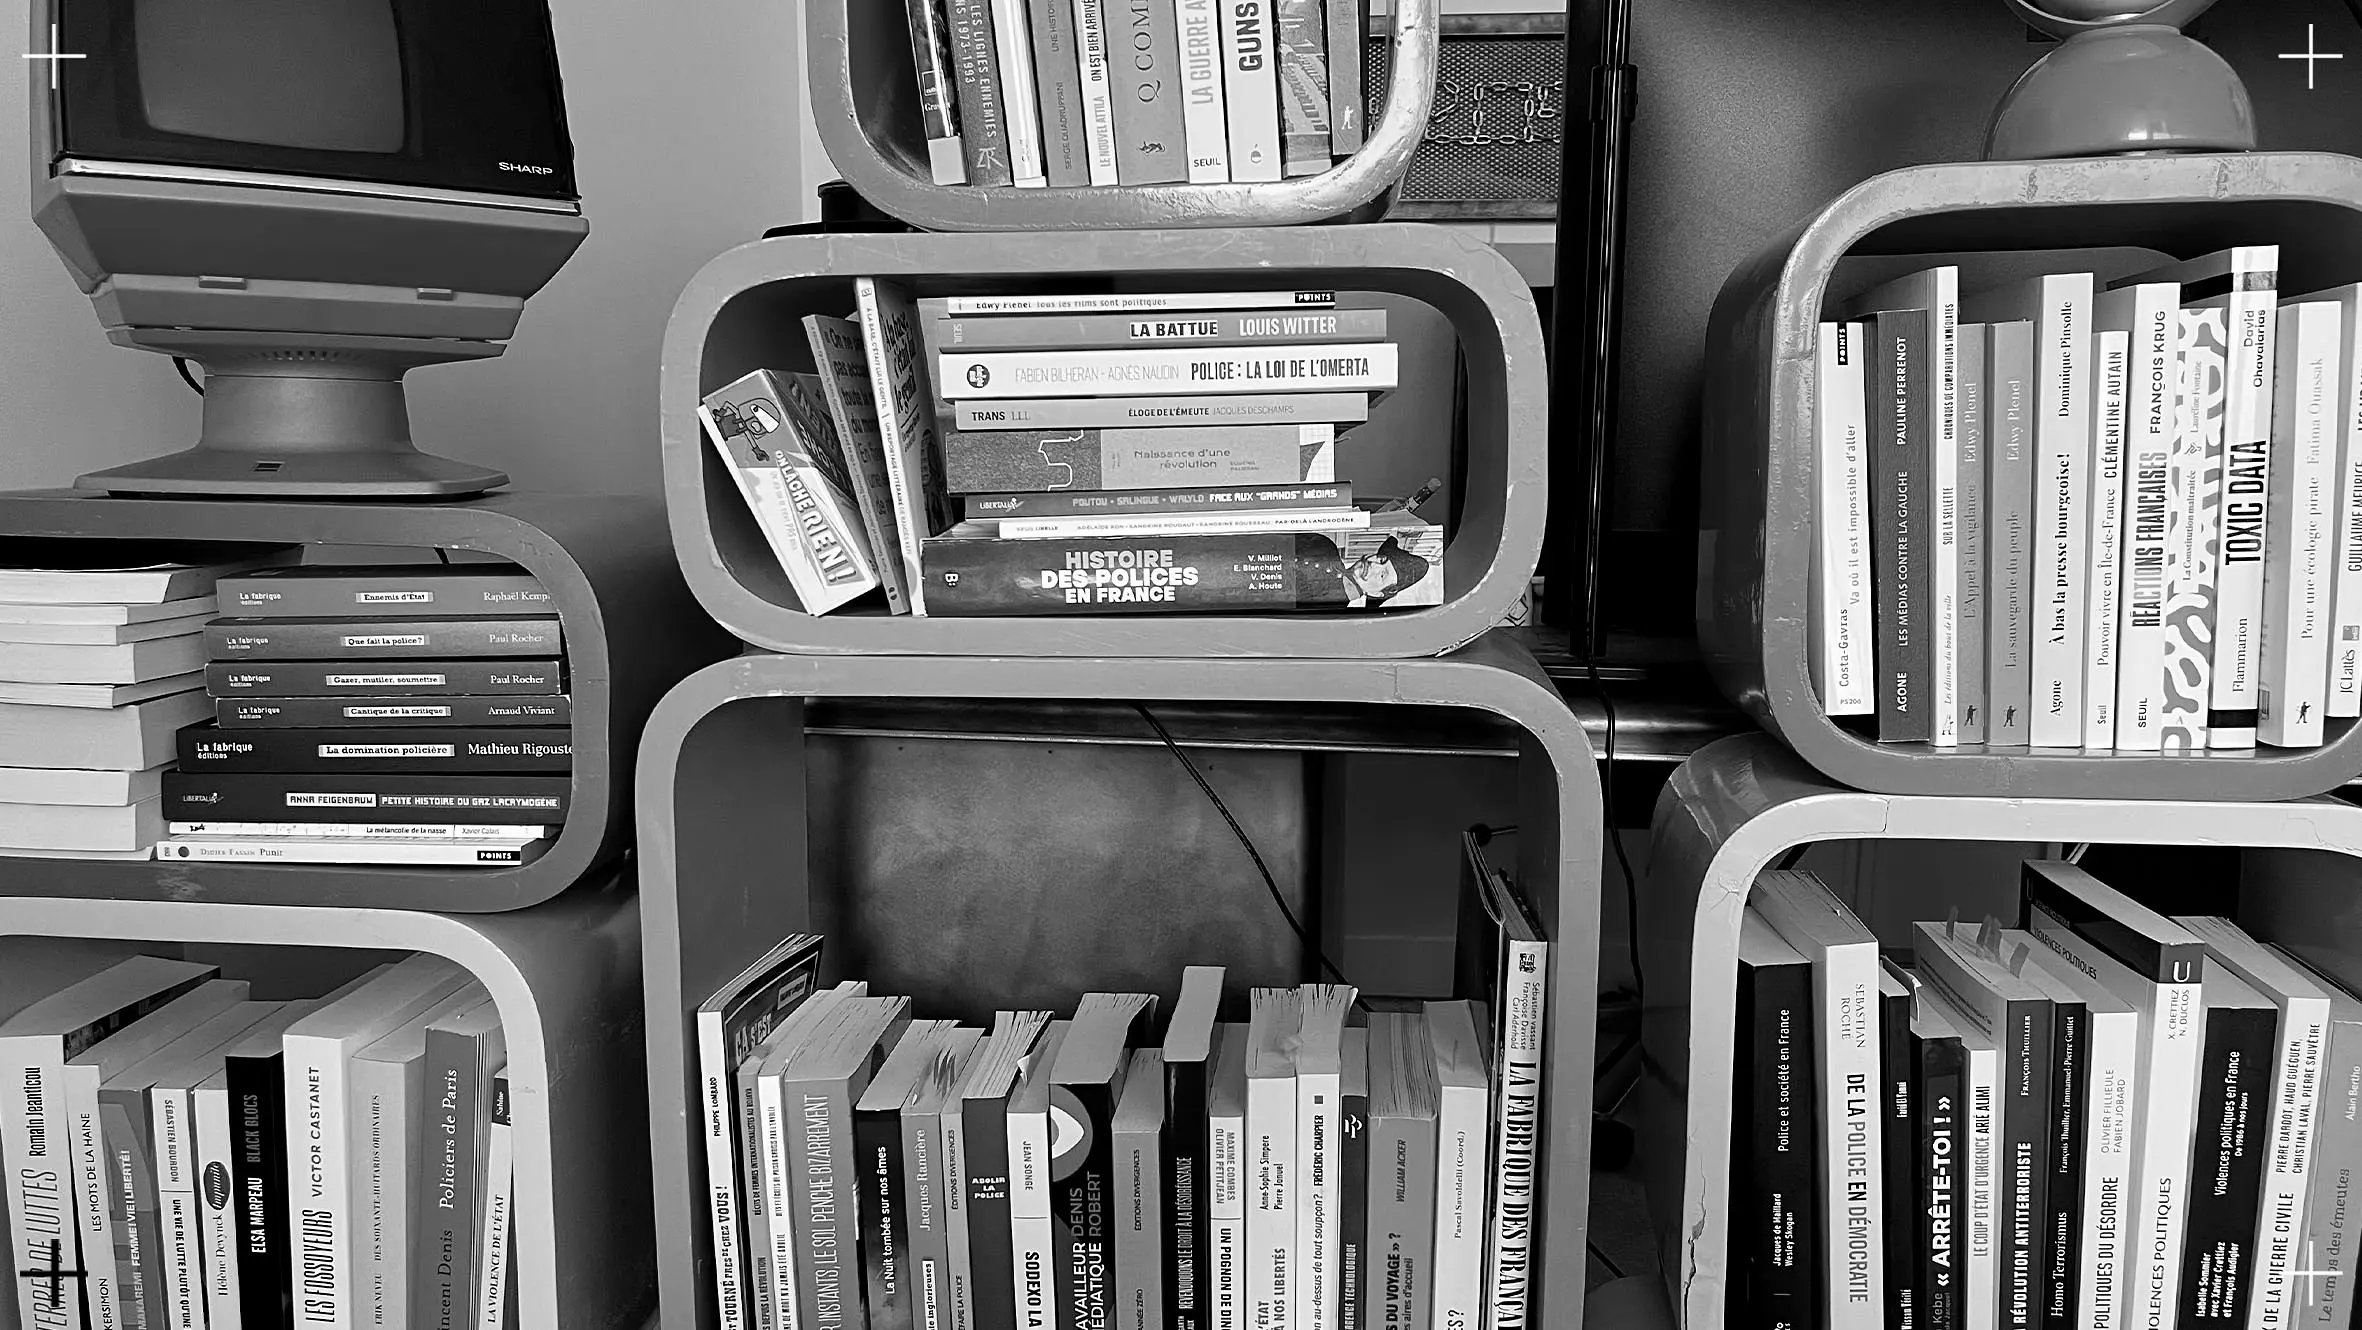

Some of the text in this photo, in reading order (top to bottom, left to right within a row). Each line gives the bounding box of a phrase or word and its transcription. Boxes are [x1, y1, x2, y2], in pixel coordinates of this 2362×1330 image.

[957, 21, 976, 84] 1973-1993
[1087, 28, 1102, 82] ON BIEN
[1188, 13, 1213, 105] LA GUERRE
[1235, 2, 1262, 72] GUNS
[970, 5, 997, 138] LES LIGNES ENNEMIES
[498, 161, 554, 176] SHARP
[1193, 157, 1221, 168] SEUIL
[1122, 298, 1166, 309] politiques
[1298, 294, 1331, 302] POINTS
[1130, 322, 1218, 337] LA BATTUE
[1240, 316, 1336, 336] LOUIS WITTER
[2243, 310, 2254, 348] David
[1015, 366, 1098, 382] FABIEN BILHERAN
[1191, 358, 1369, 380] POLICE LA LOI DE L'OMERTA
[2059, 301, 2072, 417] Dominique Pinsolle
[2150, 311, 2166, 434] FRANÇOIS KRUG
[1128, 407, 1210, 417] ÉLOGE L'ÉMEUTE
[1213, 405, 1294, 416] JACQUES DESCHAMPS
[1896, 337, 1907, 445] PAULINE PERRENOT
[972, 411, 1005, 421] TRANS
[2100, 351, 2122, 478] CLÉMENTINE AUTAIN
[1134, 448, 1231, 459] Naissance d'une
[1159, 460, 1217, 470] révolution
[1072, 498, 1108, 506] POUTOU
[1116, 496, 1160, 505] SALINGUE
[1210, 493, 1232, 502] FACE
[1235, 492, 1254, 501] AUX
[1303, 489, 1338, 499] MÉDIAS
[2225, 440, 2267, 565] TOXIC DATA
[804, 511, 856, 582] RIEN!
[2097, 488, 2115, 568] Île-de-France
[2130, 452, 2168, 627] RÉACTIONS FRANÇAISES
[1041, 566, 1199, 588] DES POLICES
[1065, 550, 1173, 569] HISTOIRE
[1896, 470, 1908, 646] LES MÉDIAS CONTRE LA GAUCHE
[483, 592, 519, 603] Raphaël
[1066, 586, 1175, 603] EN FRANCE
[348, 637, 422, 646] Que police?
[490, 633, 544, 643] Paul Rocher
[1839, 609, 1849, 687] Costa-Gavras
[2233, 618, 2247, 692] Flammarion
[490, 674, 544, 684] Paul Rocher
[1896, 672, 1908, 713] AGONE
[2050, 680, 2062, 716] Agone
[412, 708, 443, 716] critique
[488, 706, 555, 715] Arnaud Viviant
[2138, 698, 2148, 728] SEUIL
[197, 742, 253, 754] La fabrique
[342, 746, 400, 754] domination
[402, 746, 448, 756] policière
[468, 743, 519, 755] Mathieu
[290, 796, 373, 804] ANNA FEIGENBAUM
[382, 796, 412, 804] PETITE
[414, 797, 454, 805] HISTOIRE
[472, 797, 490, 806] GAZ
[2173, 961, 2191, 982] U
[2169, 989, 2179, 1030] CRETTIEZ
[2180, 990, 2190, 1024] DUCLOS
[1778, 1010, 1790, 1152] Police société France
[26, 1118, 46, 1157] Romain
[244, 1094, 260, 1163] BLACK BLOCS
[309, 1067, 322, 1197] VICTOR CASTANET
[440, 1068, 458, 1210] Policiers Paris
[2214, 1051, 2240, 1196] Violences politiques France
[80, 1113, 102, 1231] LES MOTS HAINE
[804, 1095, 835, 1248] SOL PENCHE BIZARREMENT
[916, 1129, 931, 1231] Jacques Rancière
[1024, 1164, 1033, 1191] SONGE
[1501, 1094, 1535, 1240] FABRIQUE DES
[1973, 1086, 1990, 1243] COUP D'ÉTAT ALIMI
[248, 1177, 266, 1253] ELSA MARPEAU
[876, 1147, 893, 1279] Nuit tombée âmes
[1070, 1187, 1084, 1236] DENIS
[1087, 1171, 1102, 1236] ROBERT
[1848, 1121, 1871, 1303] POLICE EN DÉMOCRATIE
[1927, 1130, 1951, 1267] ARRÊTE-TOI
[2153, 1177, 2172, 1258] POLITIQUES
[2275, 1193, 2294, 1233] CIVILE
[2330, 1168, 2350, 1229] émeutes
[2010, 1142, 2032, 1324] RÉVOLUTION ANTITERRORISTE
[2094, 1177, 2118, 1329] POLITIQUES DÉSORDRE
[302, 1210, 335, 1323] LES FOSSOYEURS
[1025, 1251, 1041, 1307] SODEXO
[1220, 1246, 1231, 1285] POGNON
[1386, 1254, 1400, 1301] VOYAGE
[2050, 1213, 2067, 1317] Homo Terrorismus
